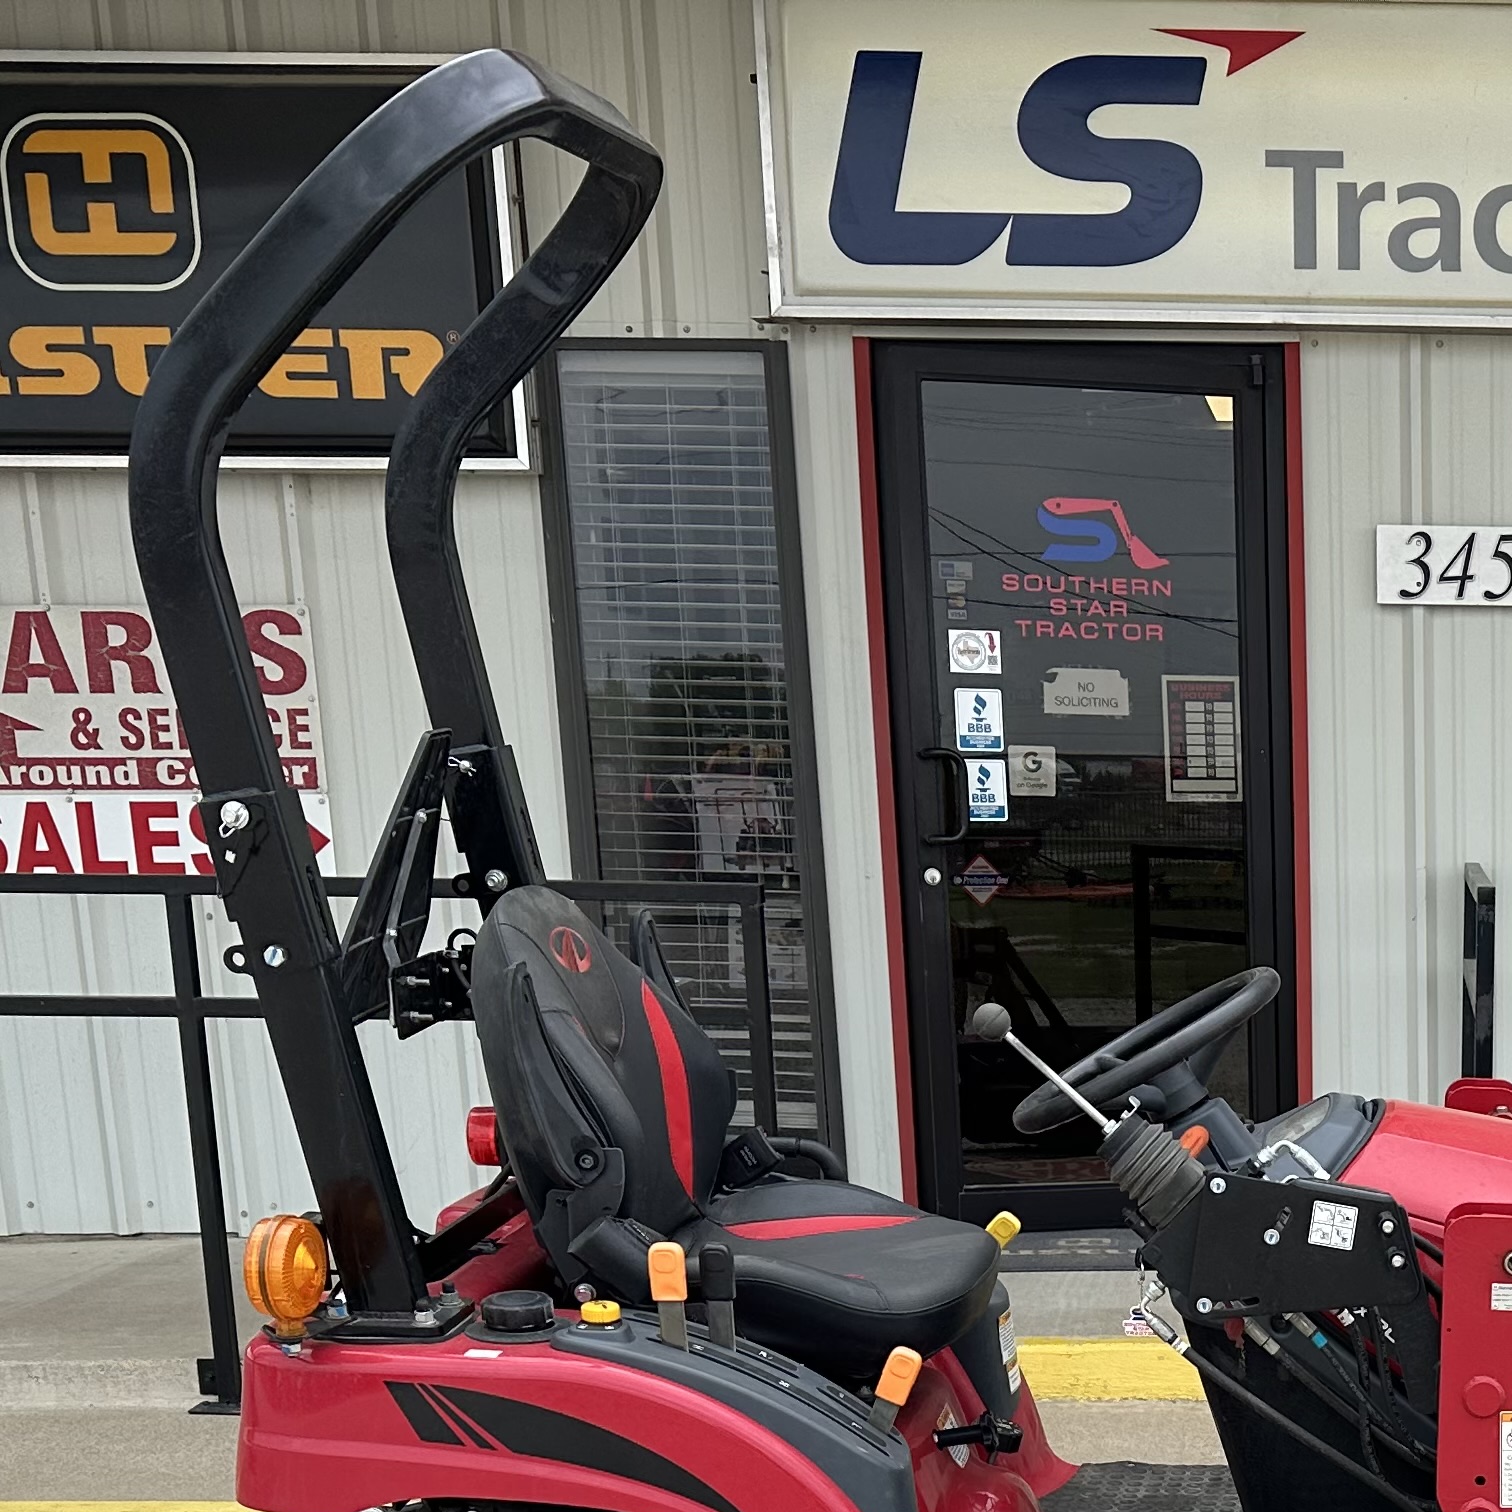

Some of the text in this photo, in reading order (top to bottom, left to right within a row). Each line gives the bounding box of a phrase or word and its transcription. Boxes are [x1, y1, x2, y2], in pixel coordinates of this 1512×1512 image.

[828, 50, 1207, 267] LS
[1001, 574, 1172, 597] SOUTHERN
[1049, 598, 1128, 618] STAR
[1014, 620, 1164, 642] TRACTOR
[2, 609, 307, 696] ARS
[1077, 682, 1095, 693] NO
[1054, 696, 1119, 708] SOLICITING
[70, 707, 104, 750] &
[967, 722, 993, 733] BBB
[0, 759, 140, 788] round
[971, 793, 997, 803] BBB
